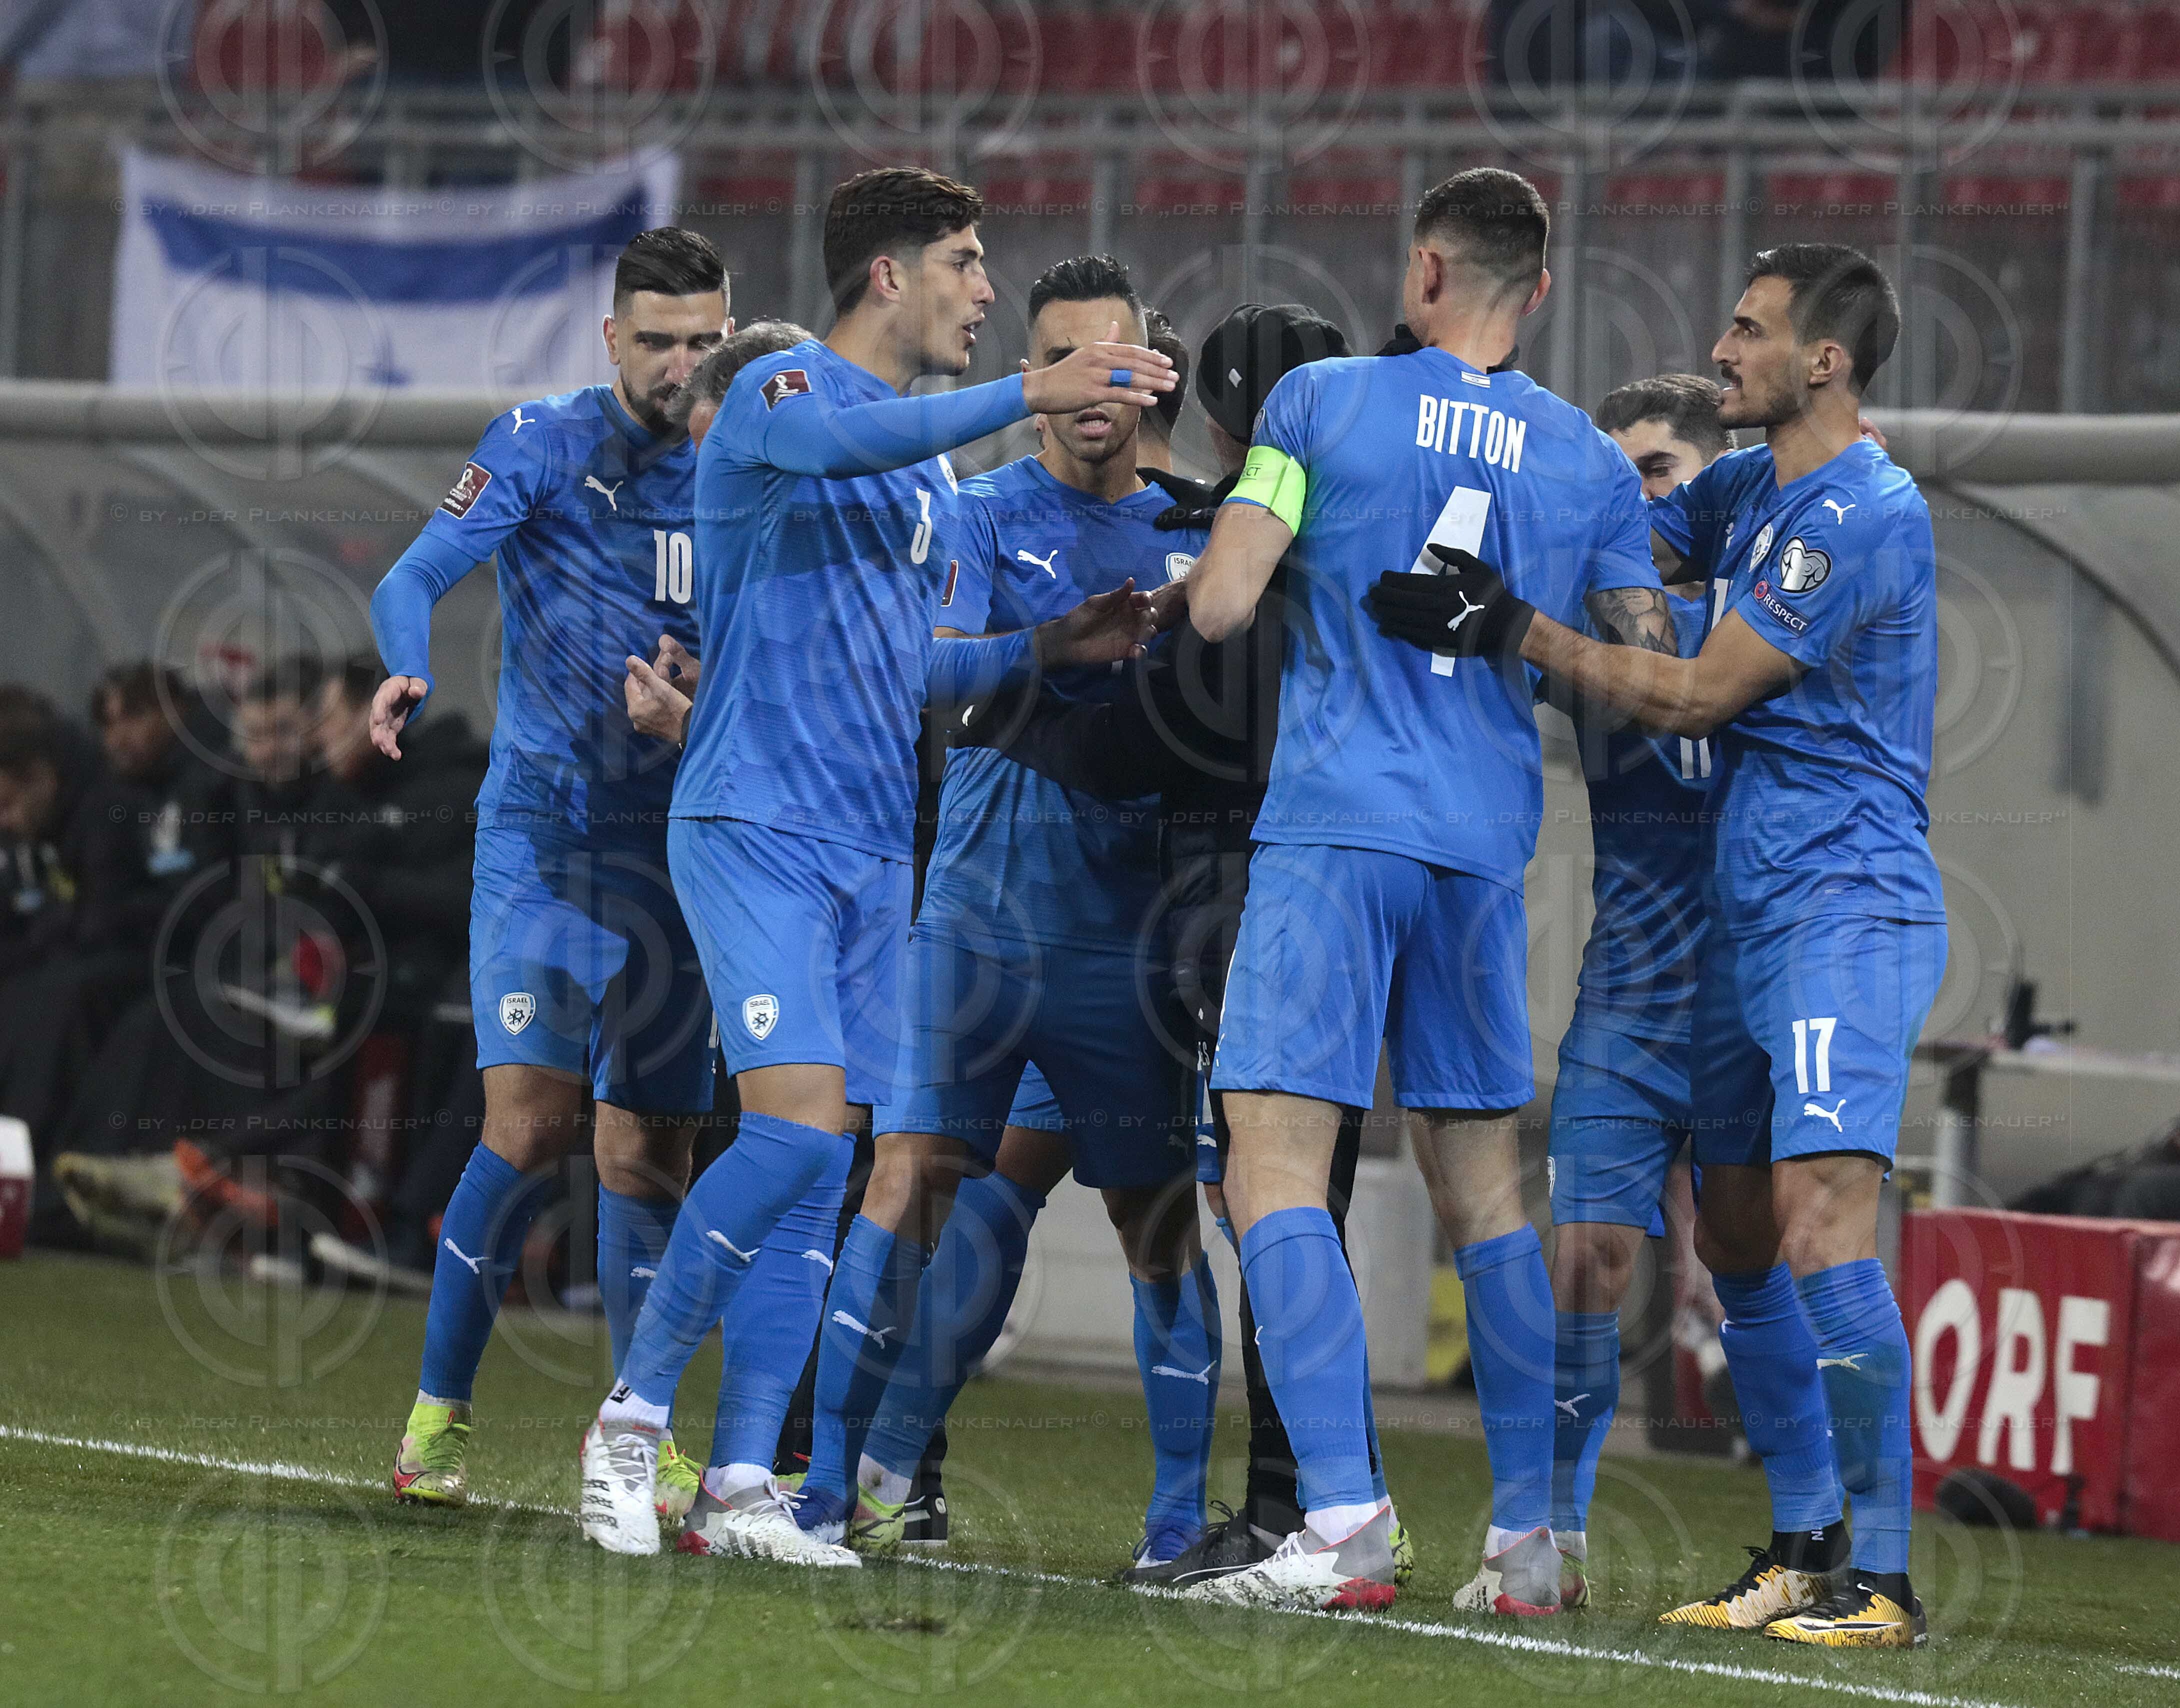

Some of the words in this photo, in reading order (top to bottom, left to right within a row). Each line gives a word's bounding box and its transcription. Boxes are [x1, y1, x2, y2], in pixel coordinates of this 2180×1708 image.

[1416, 394, 1526, 473] BITTON
[654, 530, 692, 604] 10
[1410, 486, 1491, 676] 4
[1764, 594, 1807, 630] RESPECT
[1792, 1018, 1836, 1094] 17
[1914, 1278, 2109, 1475] ORF
